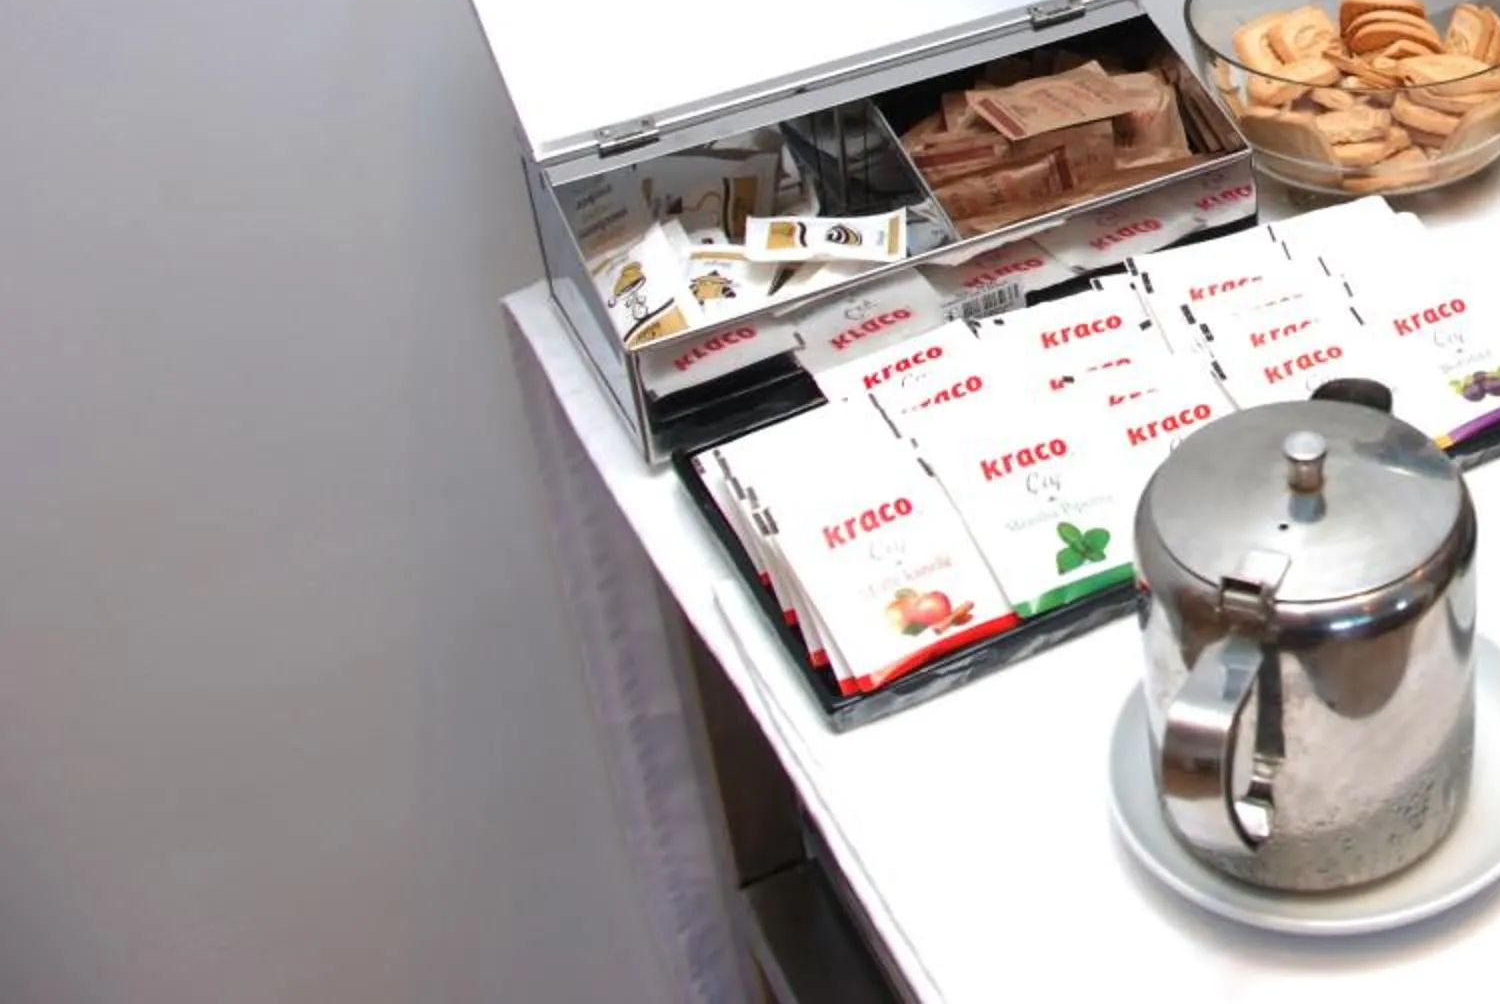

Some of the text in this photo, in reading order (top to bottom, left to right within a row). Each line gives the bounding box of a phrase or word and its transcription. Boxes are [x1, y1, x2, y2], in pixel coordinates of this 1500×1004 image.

[1040, 314, 1123, 349] kraco
[1394, 298, 1466, 336] kraco
[863, 346, 944, 390] kraco
[1263, 346, 1343, 384] kraco
[1126, 403, 1212, 447] kraco
[980, 438, 1068, 481] kraco
[823, 497, 914, 549] kraco
